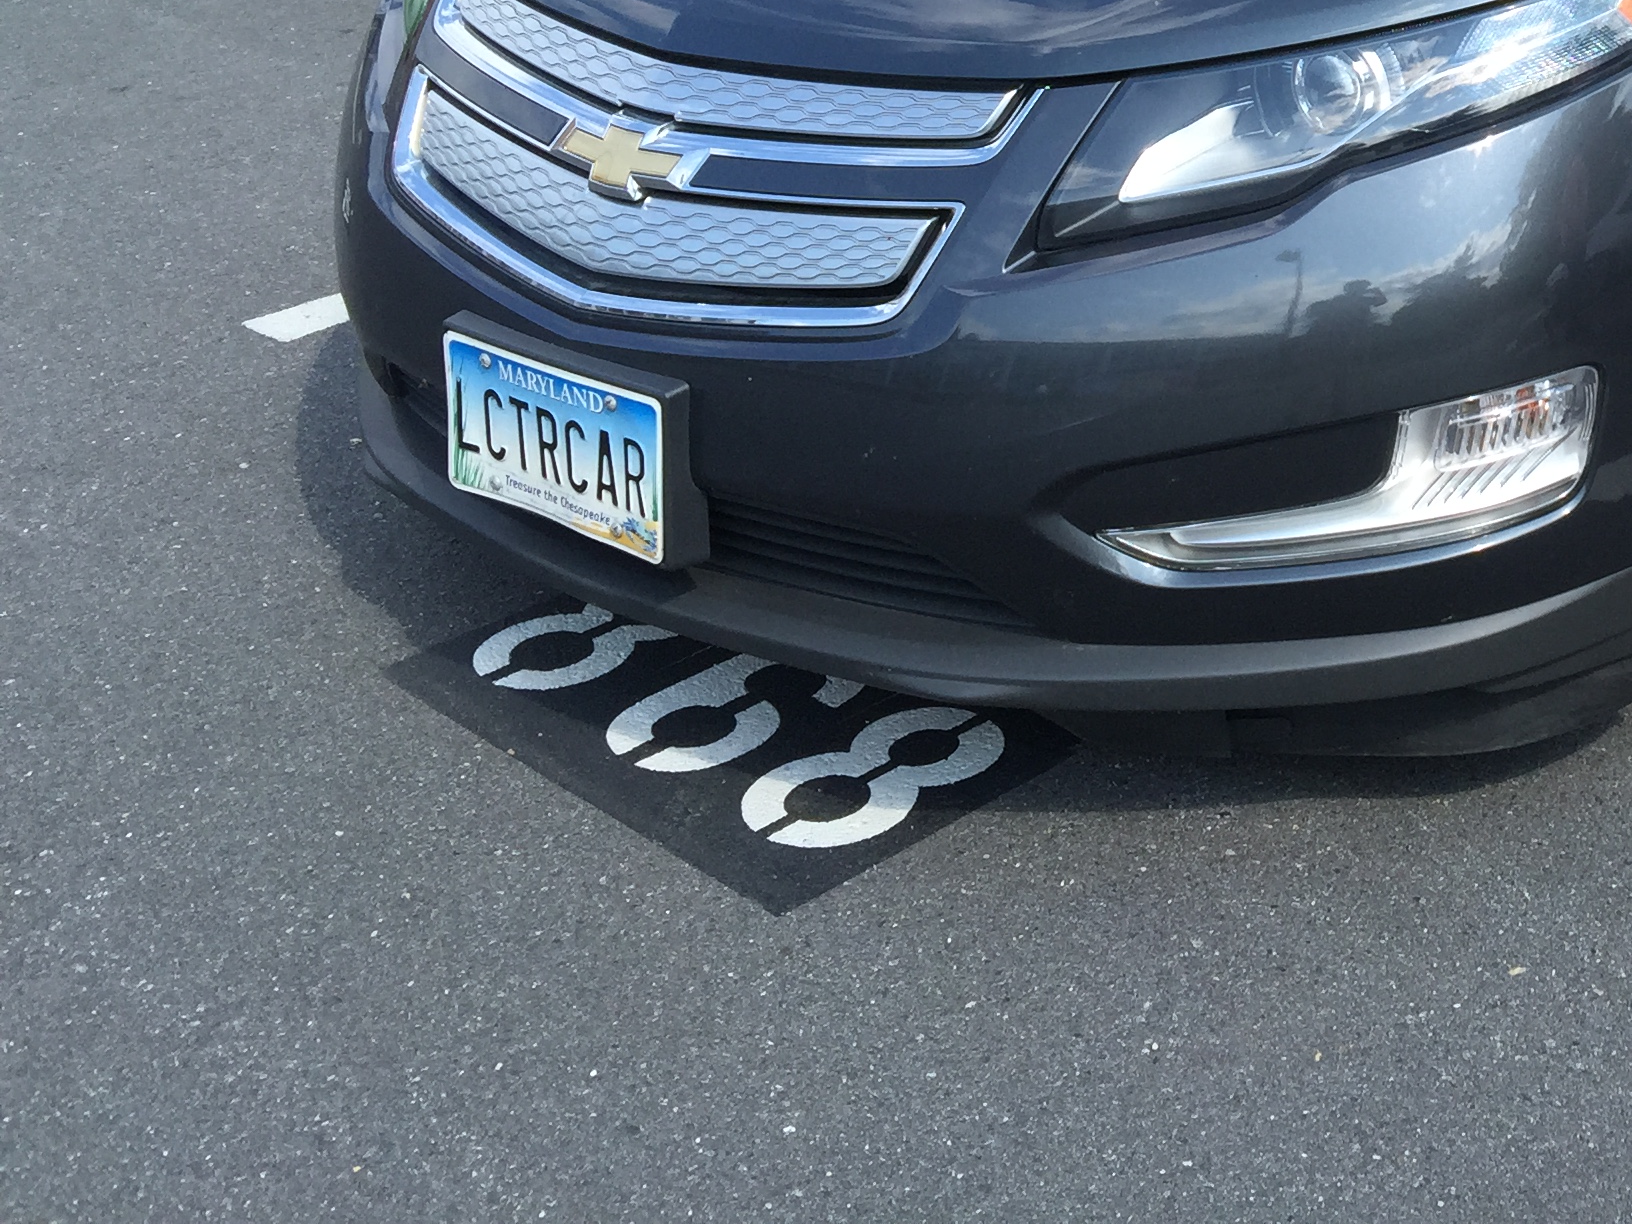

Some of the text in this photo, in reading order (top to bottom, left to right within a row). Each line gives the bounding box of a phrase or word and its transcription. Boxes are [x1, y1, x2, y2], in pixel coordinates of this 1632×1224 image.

[497, 359, 604, 414] MARYLAND
[455, 379, 646, 519] LCTRCAR
[505, 474, 611, 526] Treasure the Chesapeake
